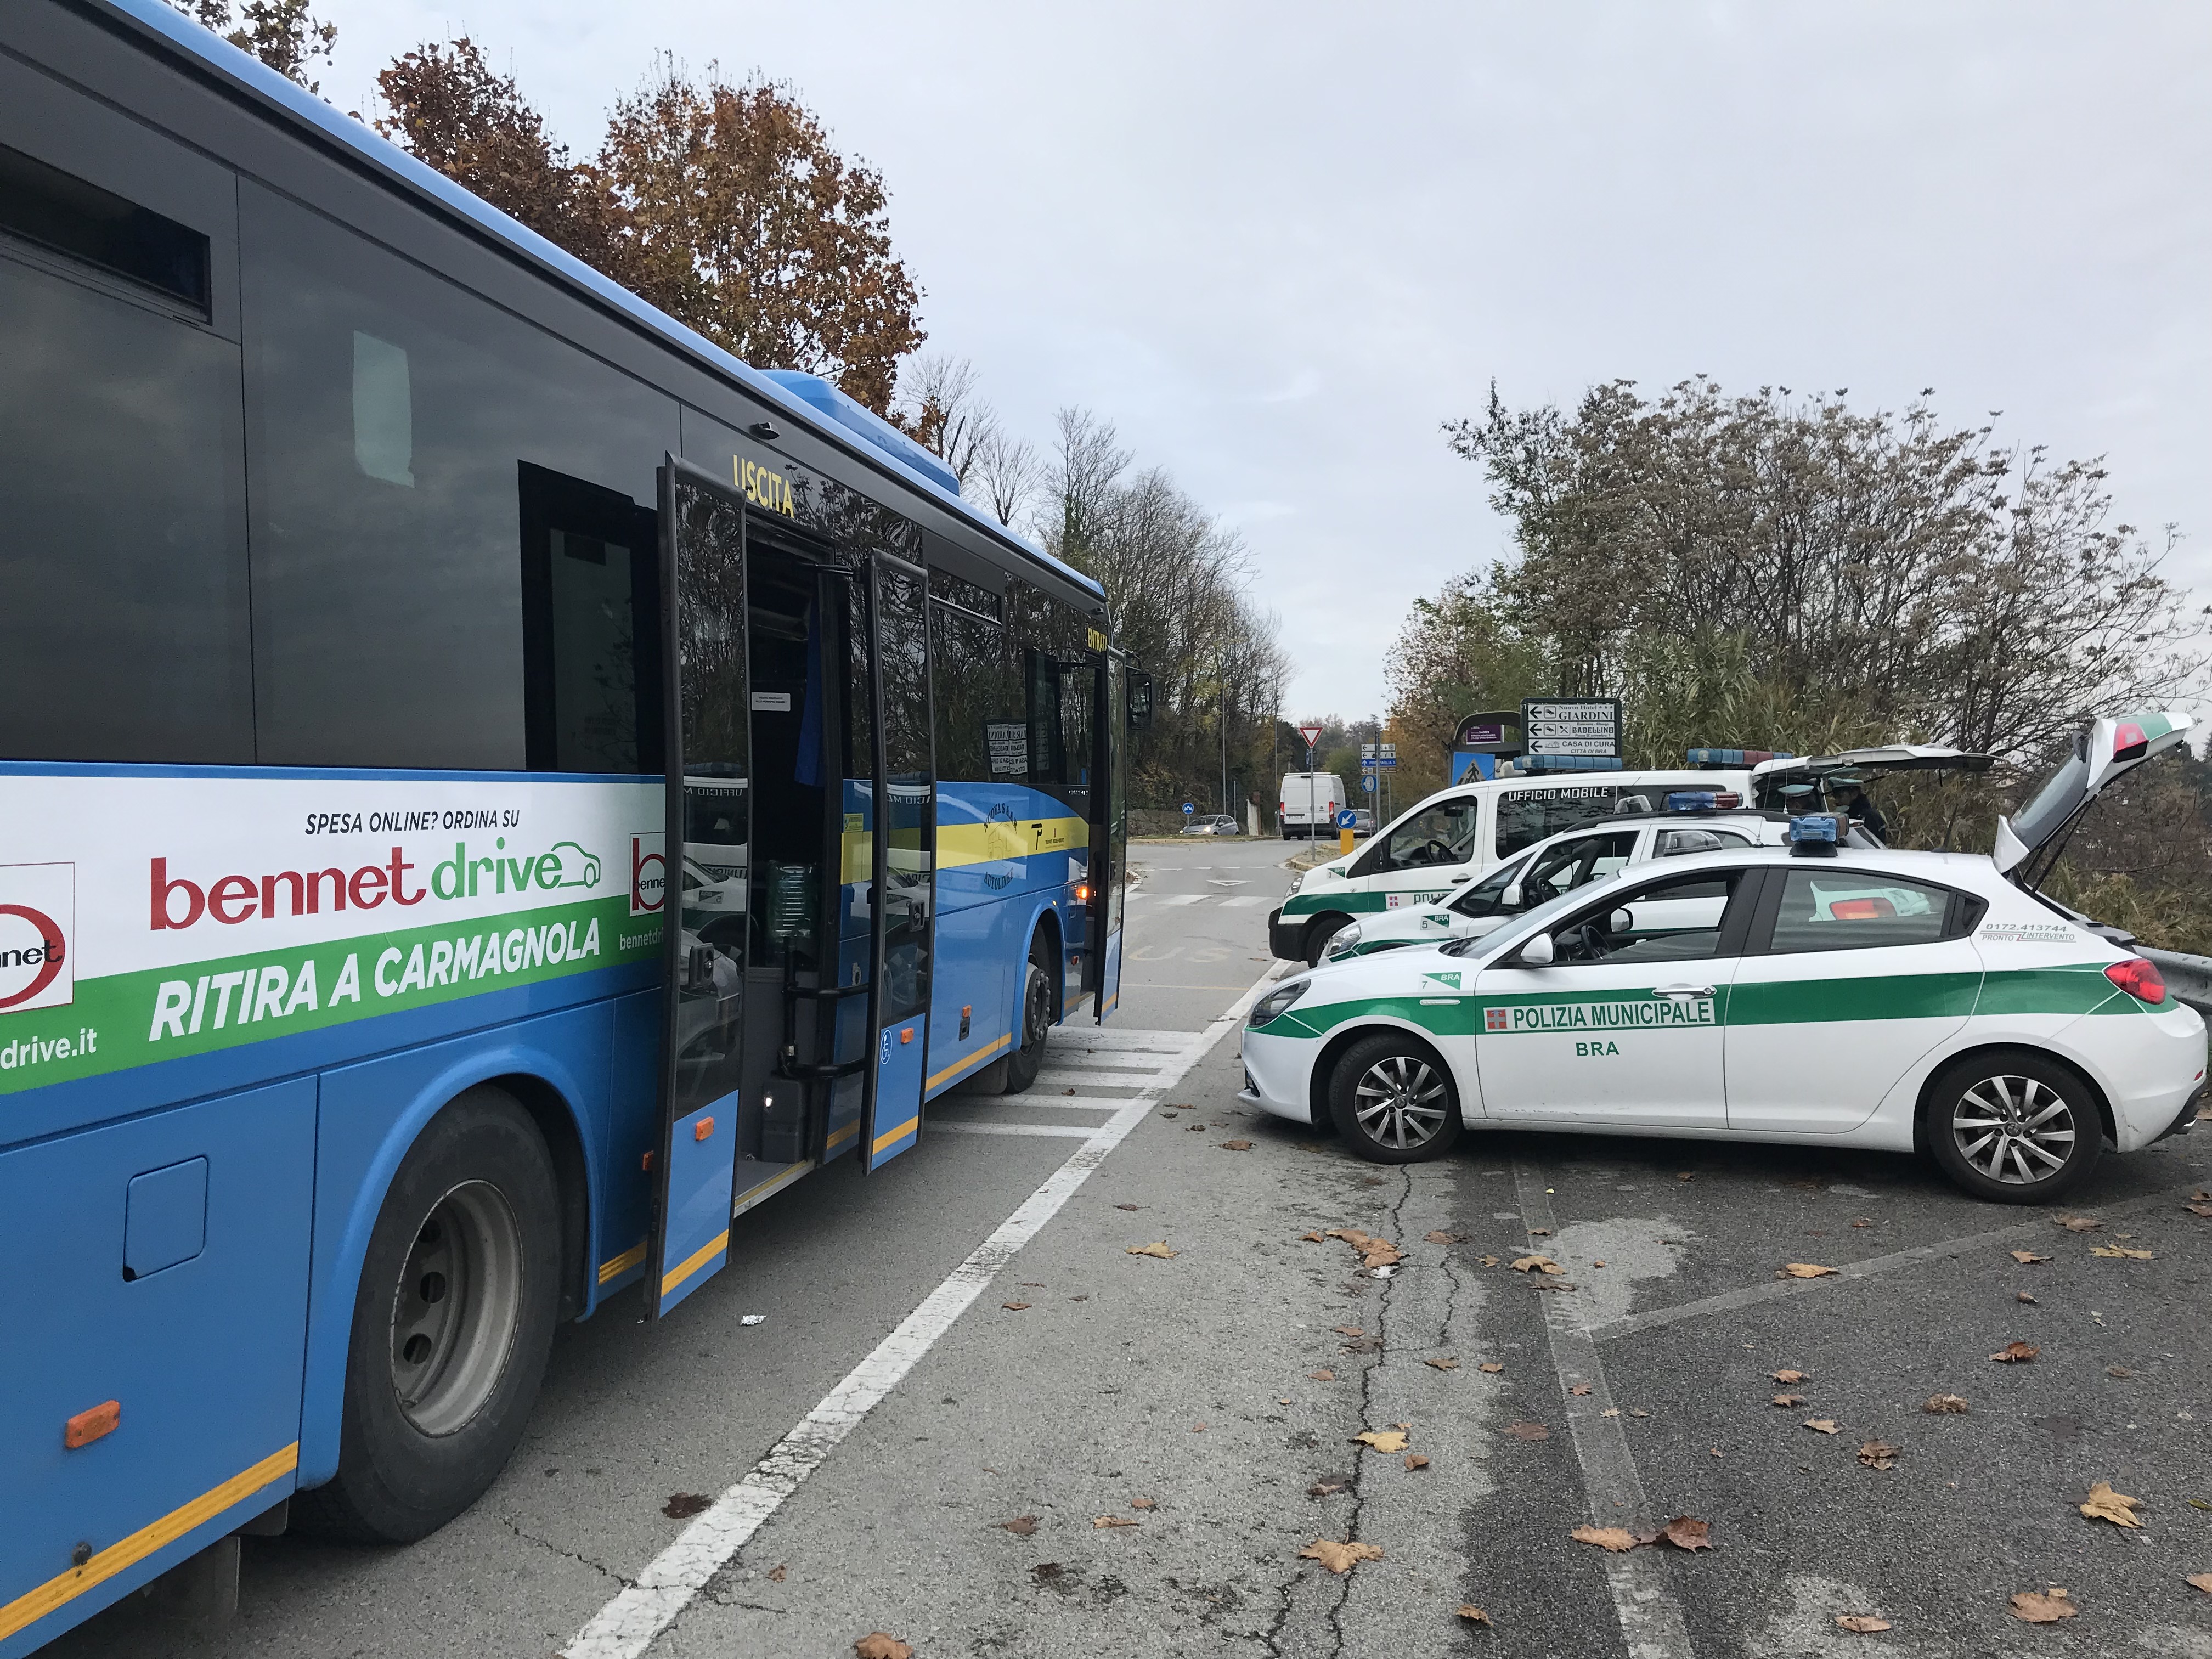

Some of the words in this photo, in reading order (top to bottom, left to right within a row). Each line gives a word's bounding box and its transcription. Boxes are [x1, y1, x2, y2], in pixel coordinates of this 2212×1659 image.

[733, 454, 794, 518] USCITA
[1559, 712, 1613, 720] GIARDINI
[1509, 789, 1556, 802] UFFICIO
[1560, 787, 1609, 799] MOBILE
[305, 812, 363, 835] SPESA
[369, 811, 438, 832] ONLINE?
[443, 810, 497, 830] ORDINA
[503, 809, 520, 827] SU
[984, 866, 1014, 890] AUTOLINEE
[1421, 921, 1428, 929] 5
[1985, 923, 2067, 932] 0172.413744
[2027, 932, 2075, 940] INTERVENTO
[0, 939, 63, 968] net
[149, 960, 318, 1042] RITIRA
[329, 953, 360, 1008] A
[374, 917, 600, 997] CARMAGNOLA
[1421, 980, 1428, 989] 7
[1513, 1006, 1587, 1029] POLIZIA
[1591, 1001, 1711, 1026] MUNICIPALE
[1576, 1041, 1620, 1057] BRA
